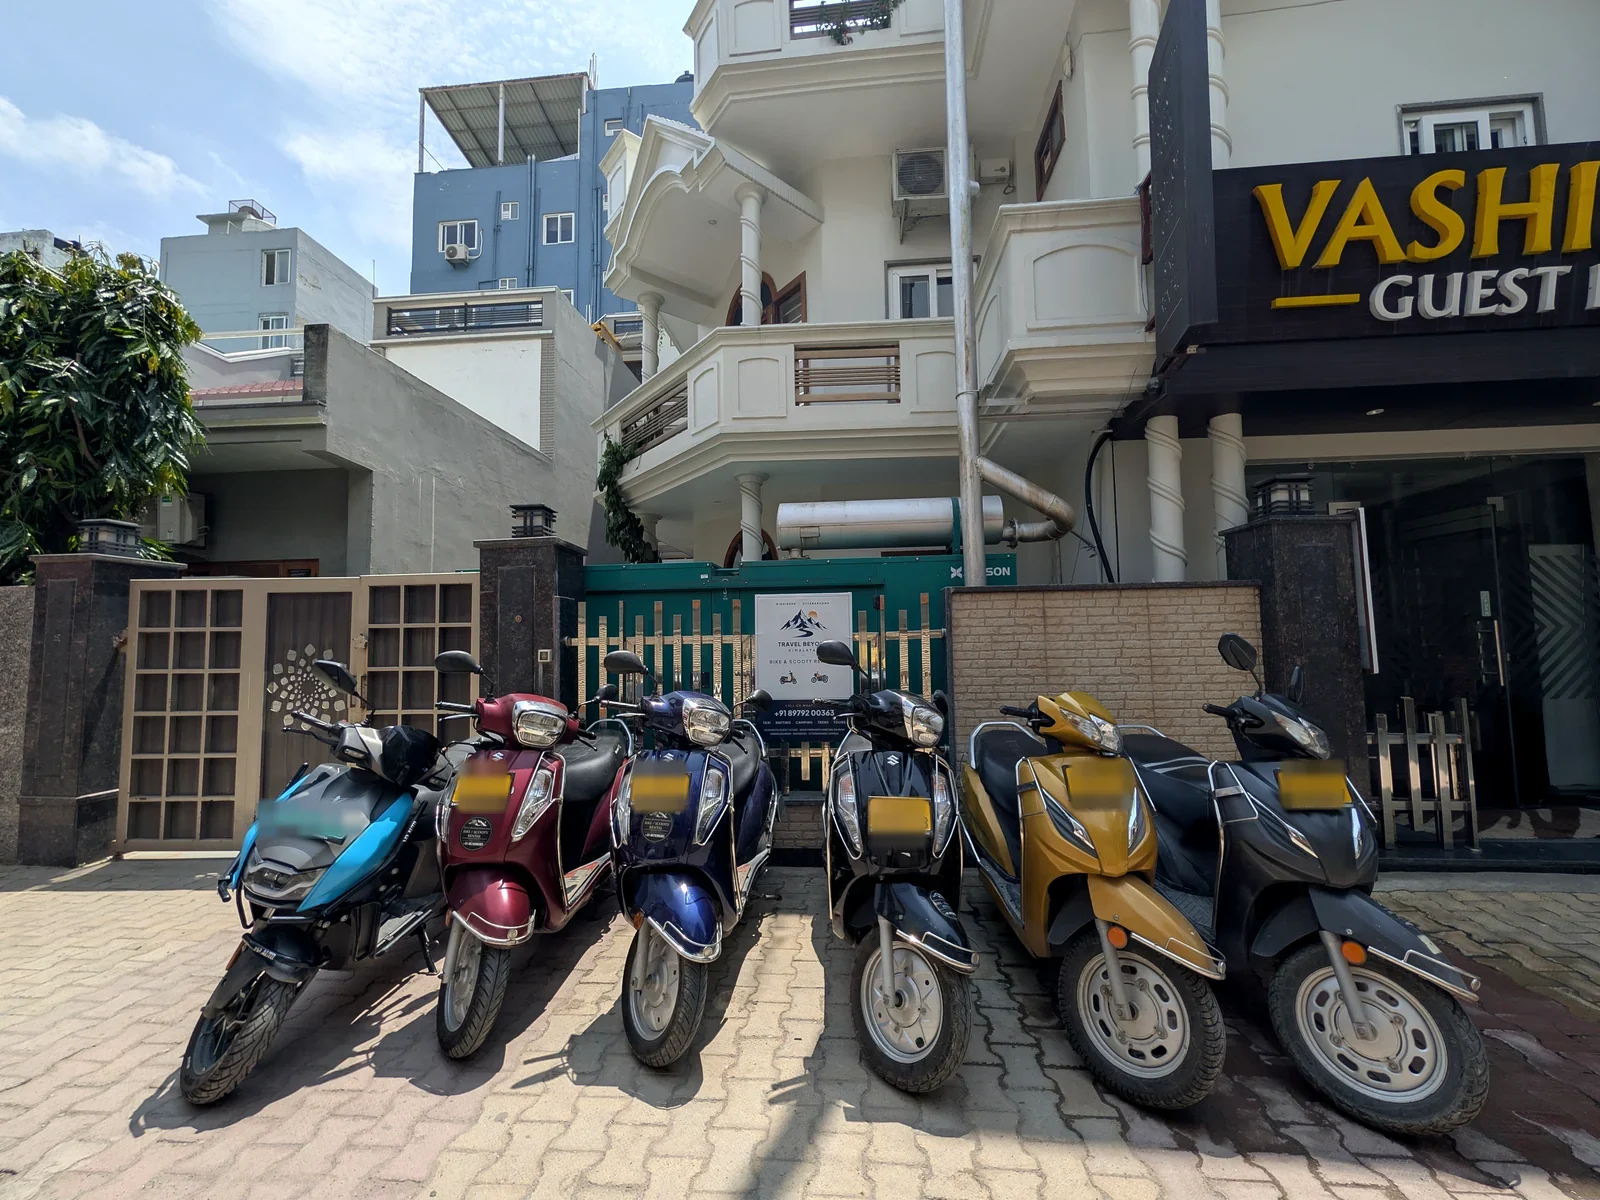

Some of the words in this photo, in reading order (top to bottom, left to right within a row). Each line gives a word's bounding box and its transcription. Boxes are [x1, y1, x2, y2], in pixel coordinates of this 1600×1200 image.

[1252, 161, 1600, 270] VASHI
[1369, 265, 1573, 322] GUEST
[985, 566, 1011, 577] SON
